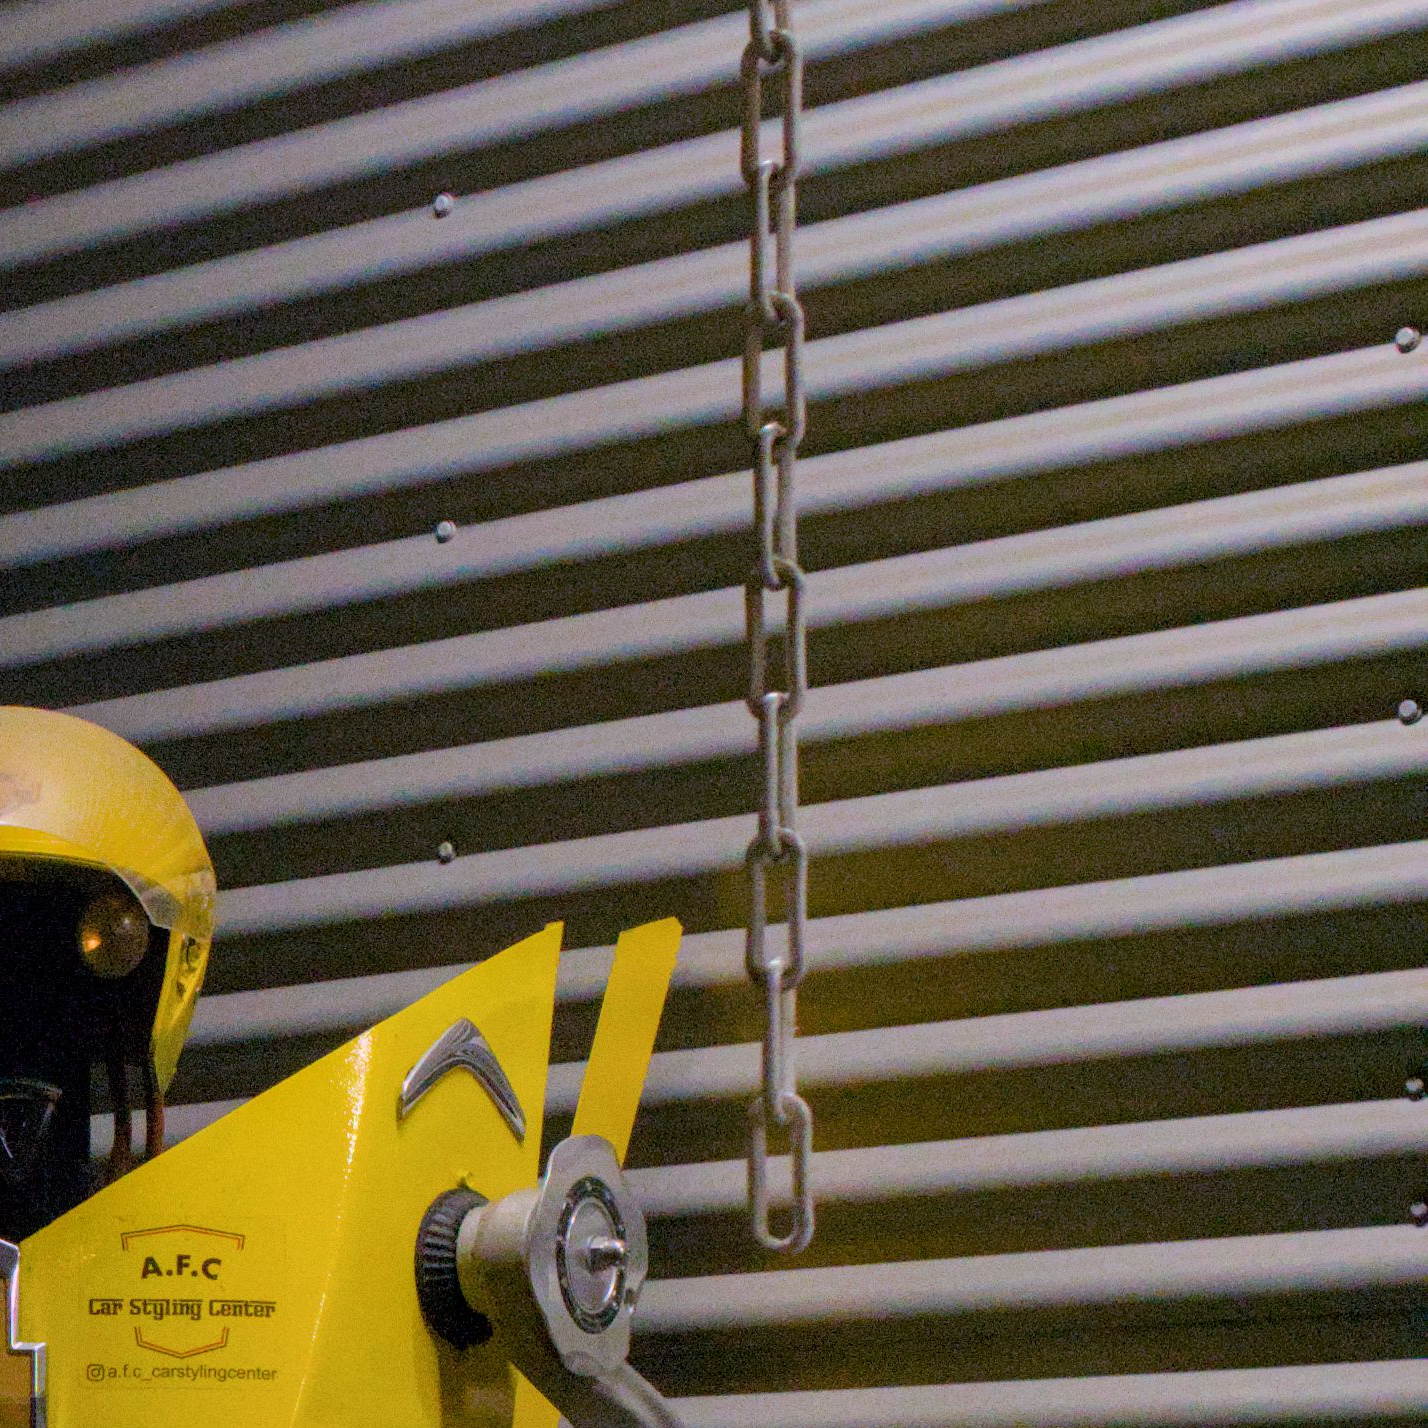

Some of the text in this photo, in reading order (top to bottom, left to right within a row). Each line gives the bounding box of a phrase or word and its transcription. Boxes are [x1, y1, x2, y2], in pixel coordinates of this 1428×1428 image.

[140, 1254, 222, 1281] A.F.C
[88, 1299, 277, 1321] Car Styling Center
[108, 1363, 278, 1382] a.f.c_carstylingcenter
